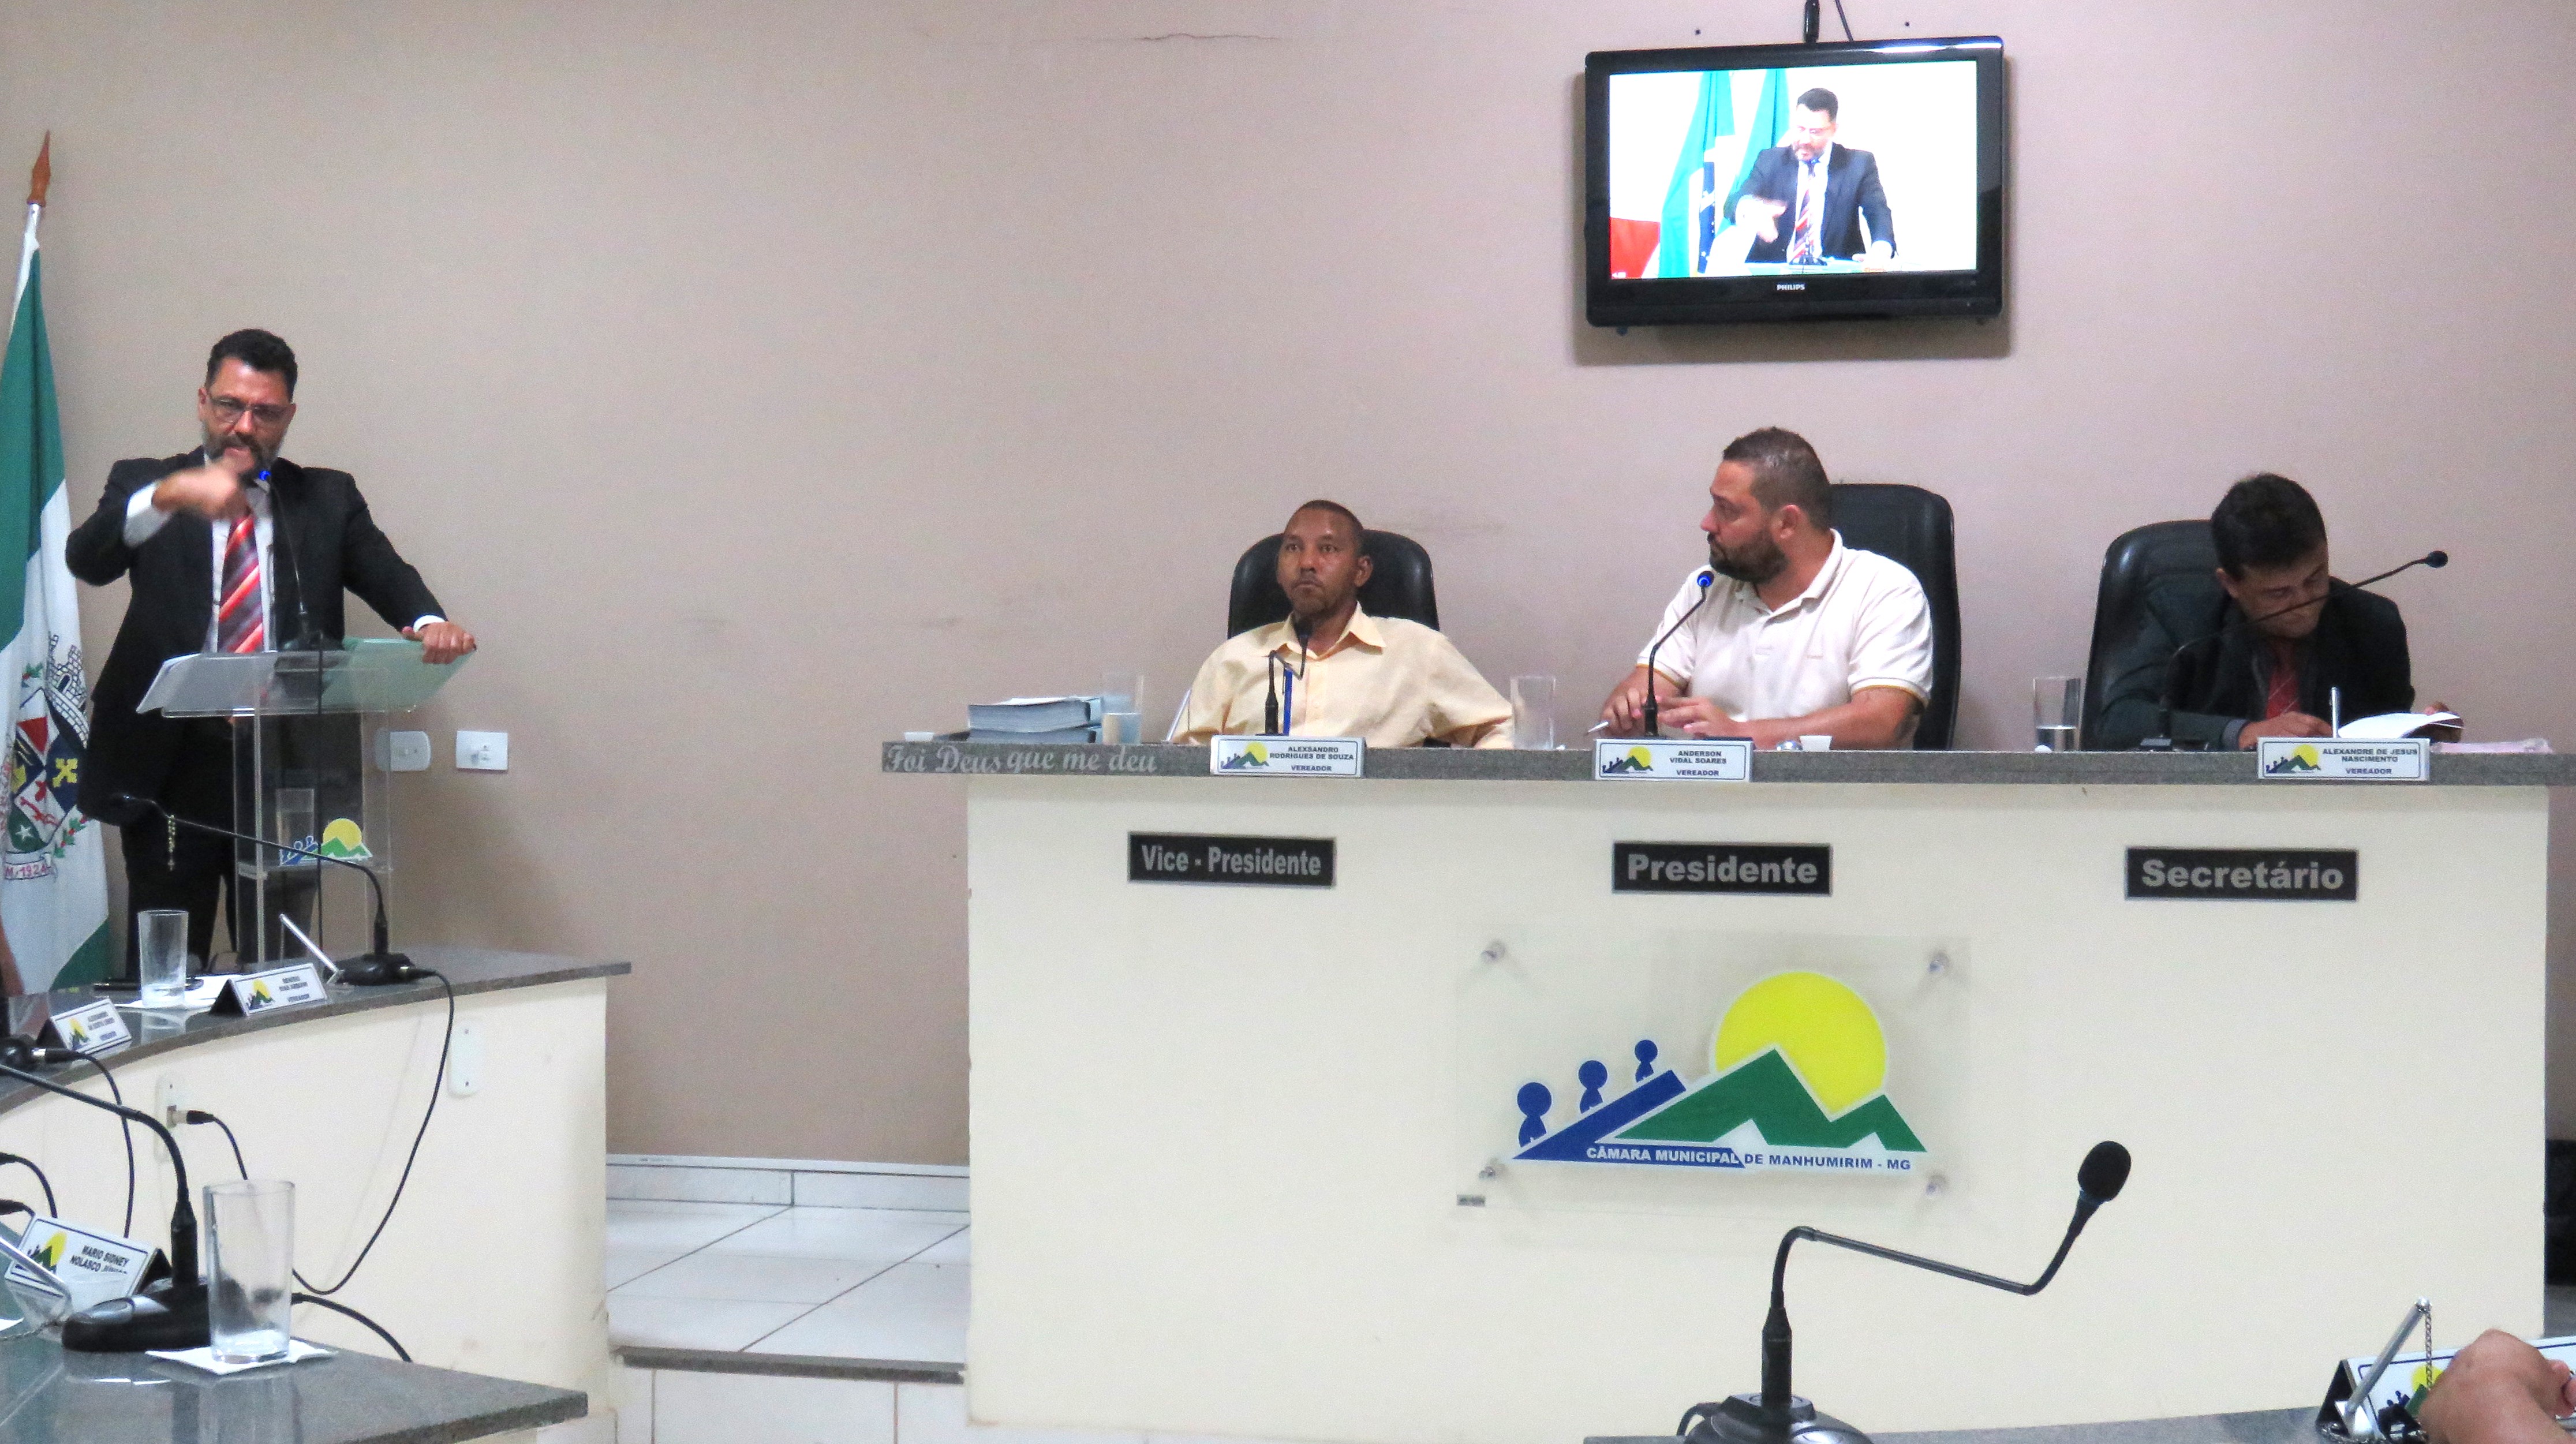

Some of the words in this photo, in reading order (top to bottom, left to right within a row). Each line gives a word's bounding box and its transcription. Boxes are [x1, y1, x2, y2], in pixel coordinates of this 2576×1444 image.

[888, 745, 926, 772] Foi
[935, 744, 1001, 774] Deus
[1007, 749, 1055, 774] que
[1063, 749, 1104, 771] me
[1109, 745, 1157, 773] deu
[1141, 844, 1189, 872] Vice
[1208, 846, 1321, 876] Presidente
[1628, 854, 1818, 884] Presidente
[2141, 859, 2344, 889] Secretário
[1586, 1146, 1651, 1161] CÂMARA
[1655, 1150, 1739, 1164] MUNICIPAL
[1744, 1154, 1763, 1165] DE
[1769, 1155, 1873, 1169] MANHUMIRIM
[1887, 1159, 1910, 1170] MG
[70, 1255, 101, 1272] NOLASCO
[82, 1245, 104, 1259] MARIO
[103, 1252, 130, 1267] SIDNEY
